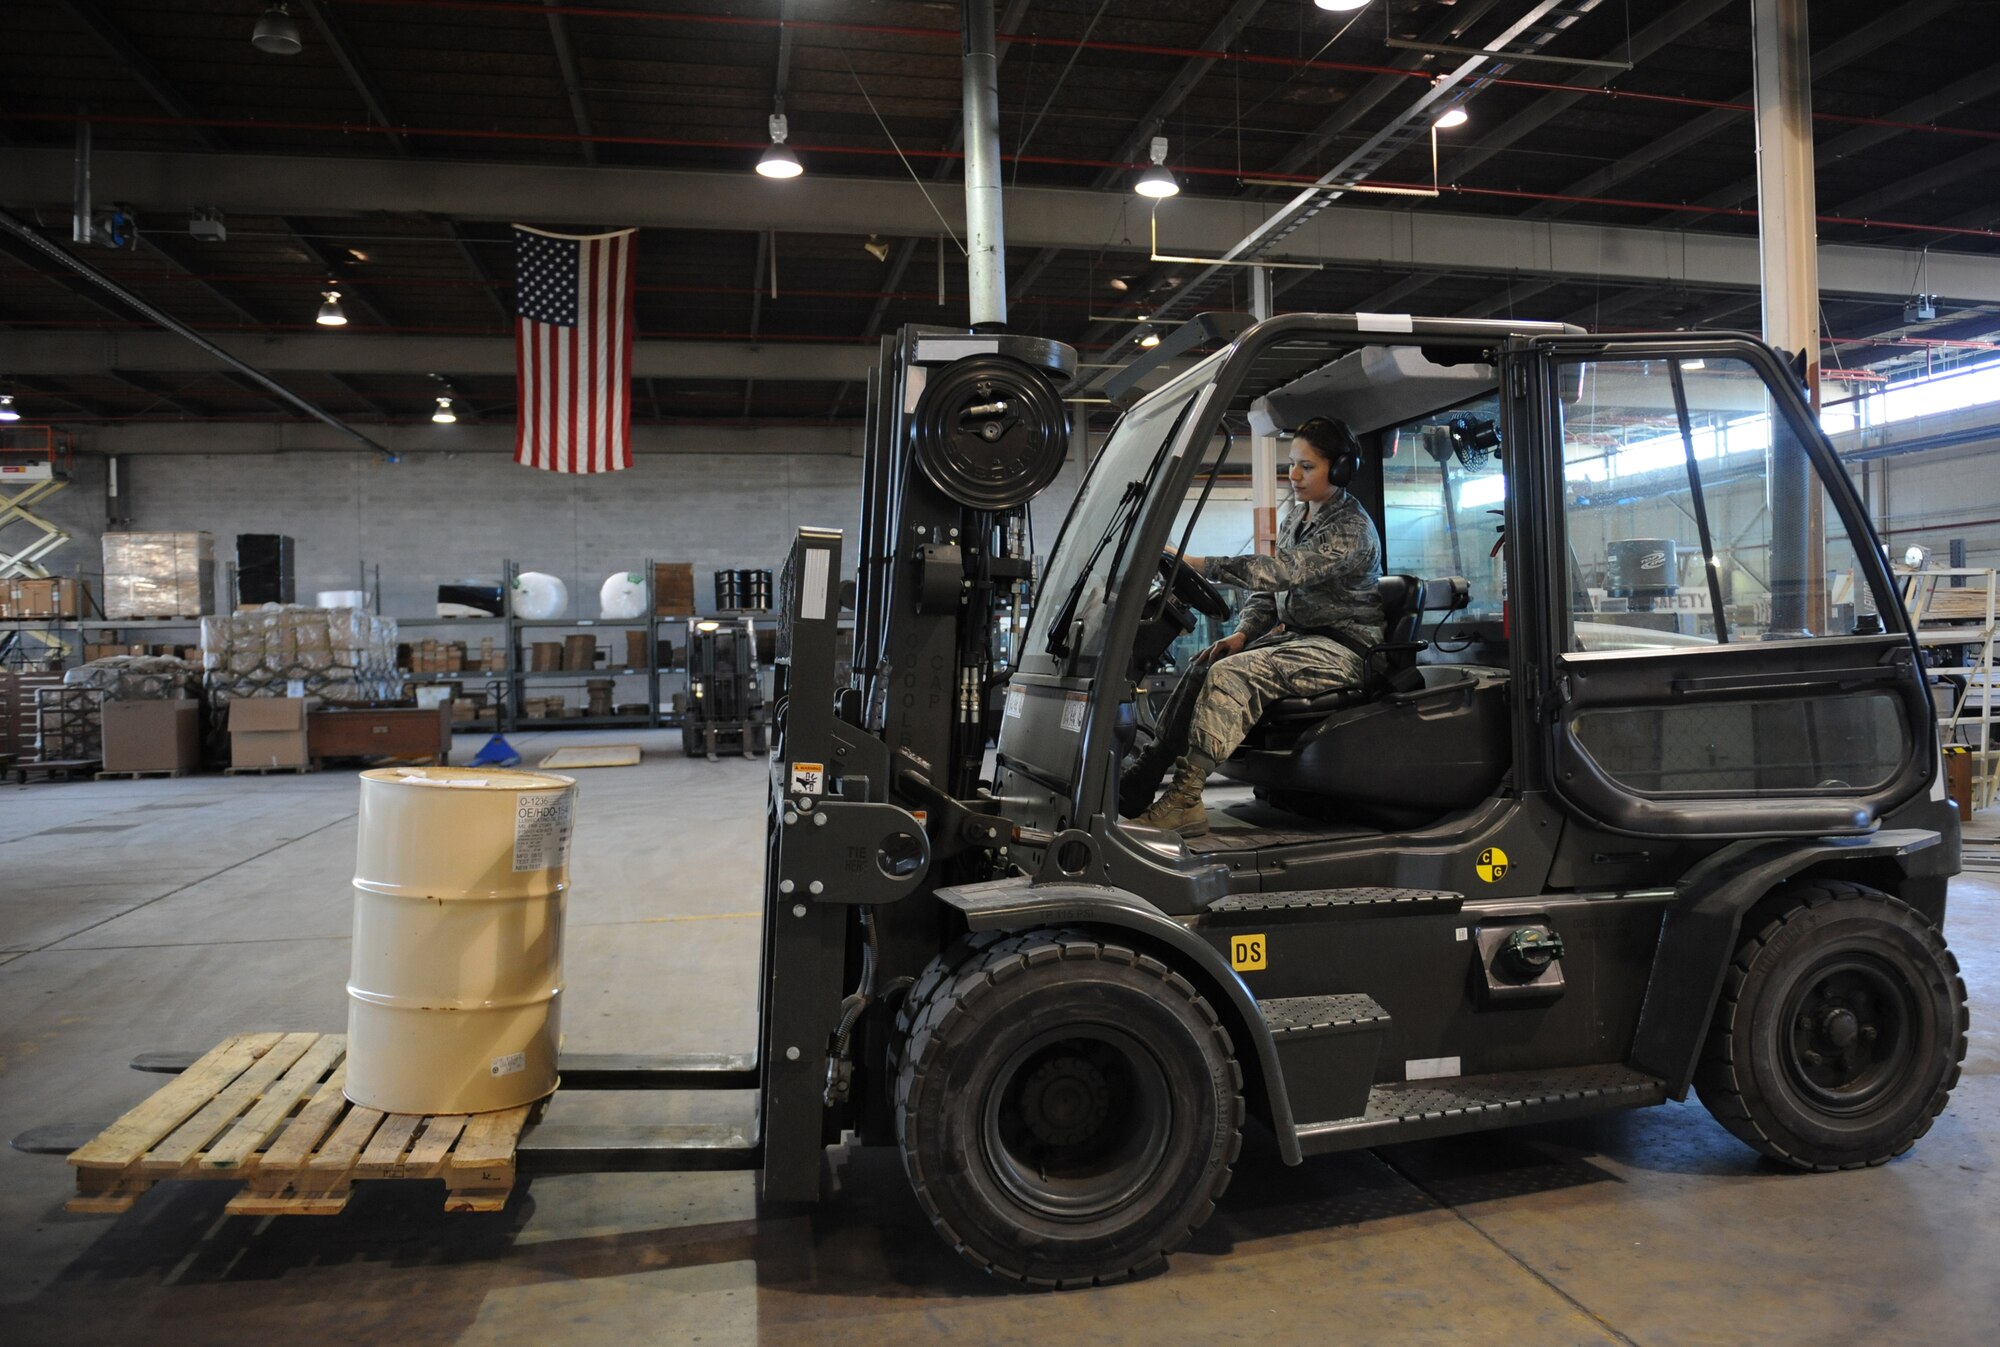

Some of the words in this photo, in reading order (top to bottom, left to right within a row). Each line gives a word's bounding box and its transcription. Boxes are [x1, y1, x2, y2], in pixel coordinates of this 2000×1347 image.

[847, 846, 867, 858] TIE
[1483, 853, 1490, 863] C
[1494, 867, 1502, 877] G
[1236, 942, 1261, 963] DS
